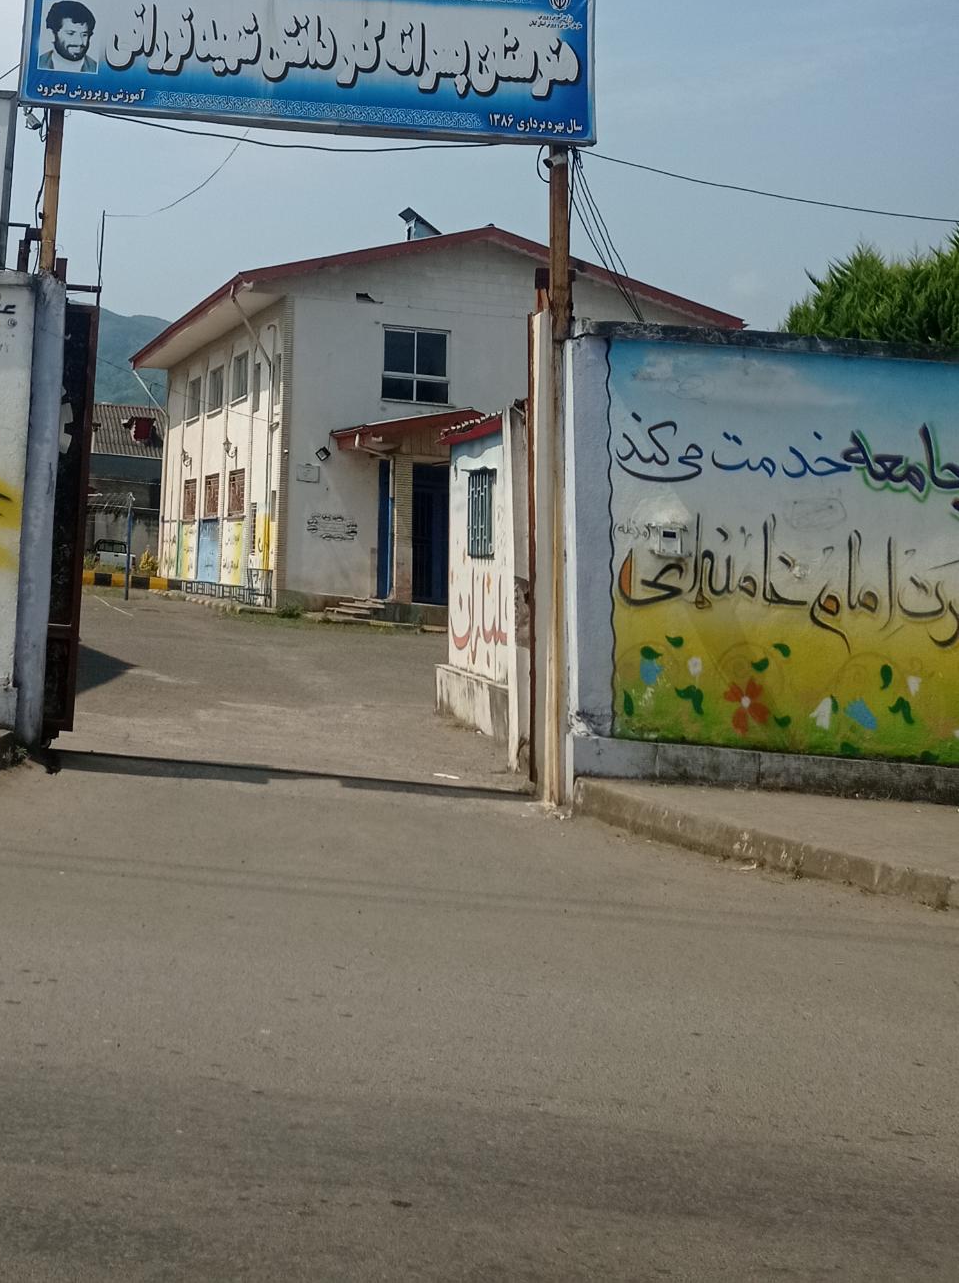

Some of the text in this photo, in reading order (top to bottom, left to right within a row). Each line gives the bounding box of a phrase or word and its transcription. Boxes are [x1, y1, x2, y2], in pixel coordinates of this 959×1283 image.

[195, 13, 263, 77] شهید
[386, 21, 471, 99] پسرانه
[471, 27, 579, 99] هنرستان
[36, 83, 146, 103] آموزش و پرورش لنگرود
[489, 113, 583, 133] سال بهره برداری ۱۳۸۶
[711, 430, 853, 479] خدمت
[809, 529, 893, 654] امام
